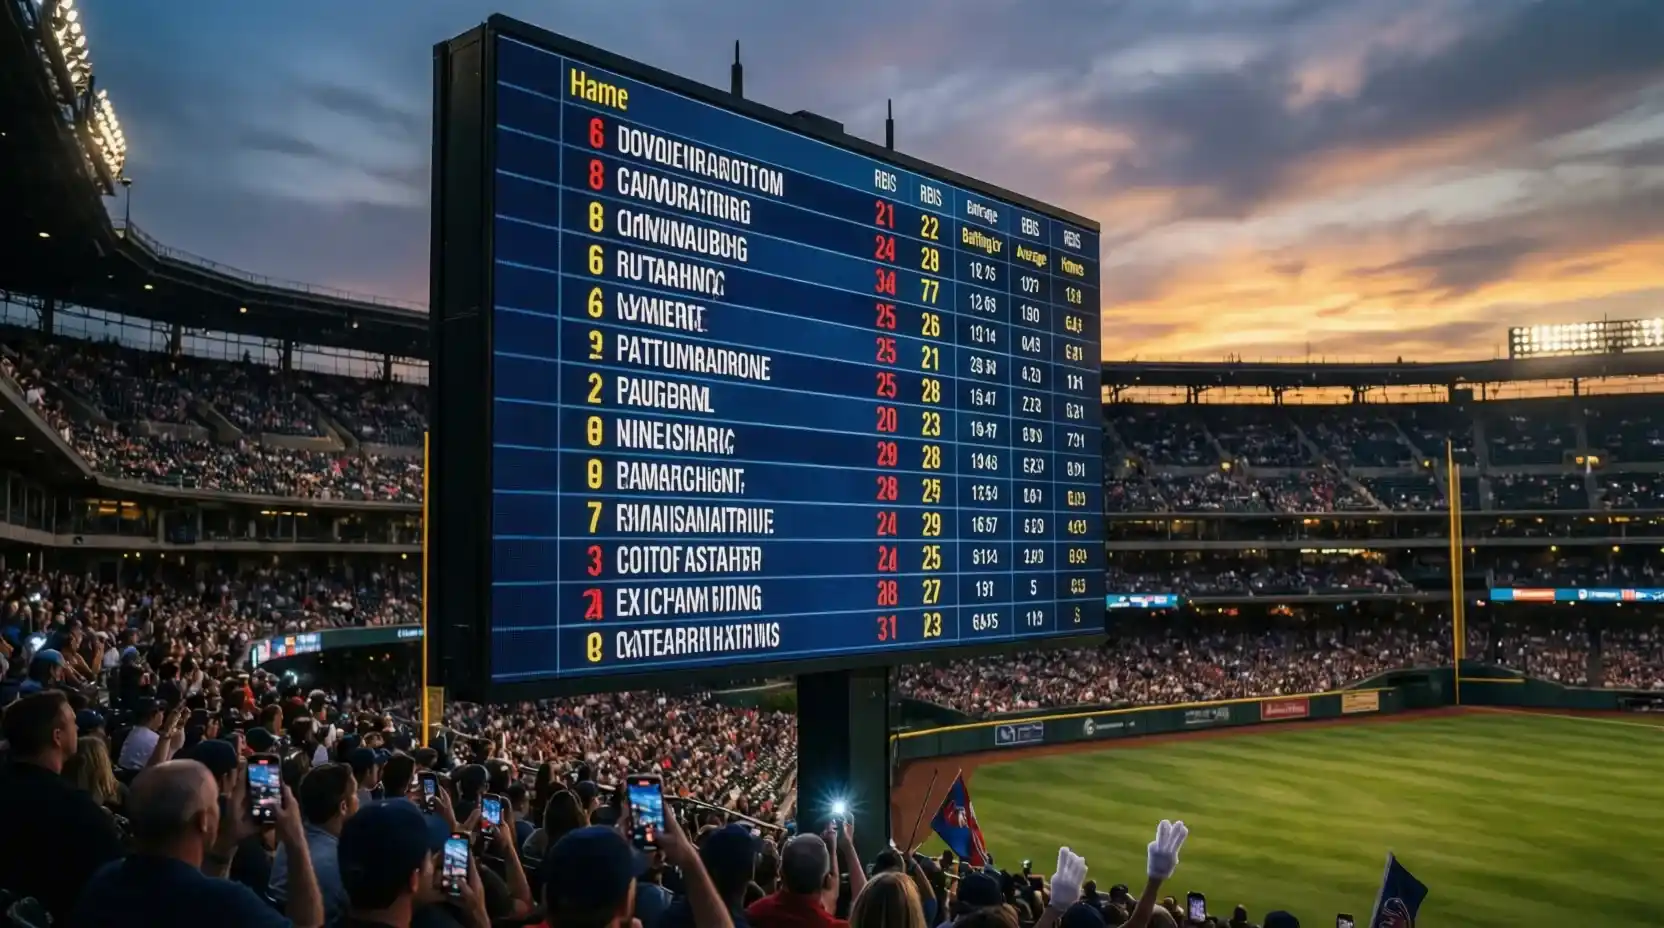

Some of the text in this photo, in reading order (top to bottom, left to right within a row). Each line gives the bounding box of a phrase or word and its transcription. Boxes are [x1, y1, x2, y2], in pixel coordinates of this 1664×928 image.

[590, 118, 603, 148] 6
[875, 200, 894, 229] 21
[922, 215, 938, 239] 22
[590, 160, 603, 189] 8
[874, 236, 895, 262] 24
[921, 247, 939, 274] 28
[589, 245, 603, 274] 6
[877, 304, 895, 329] 25
[922, 313, 940, 337] 26
[921, 279, 939, 303] 77
[589, 287, 602, 317] 6
[877, 338, 896, 363] 25
[922, 346, 938, 370] 21
[877, 372, 896, 398] 25
[922, 379, 940, 402] 28
[588, 373, 602, 403] 2
[877, 407, 896, 432] 20
[923, 412, 940, 436] 23
[923, 445, 940, 468] 28
[588, 502, 602, 532] 7
[923, 512, 940, 536] 29
[588, 546, 601, 576] 3
[923, 546, 940, 569] 25
[923, 580, 940, 603] 27
[878, 616, 896, 640] 31
[924, 613, 941, 637] 23
